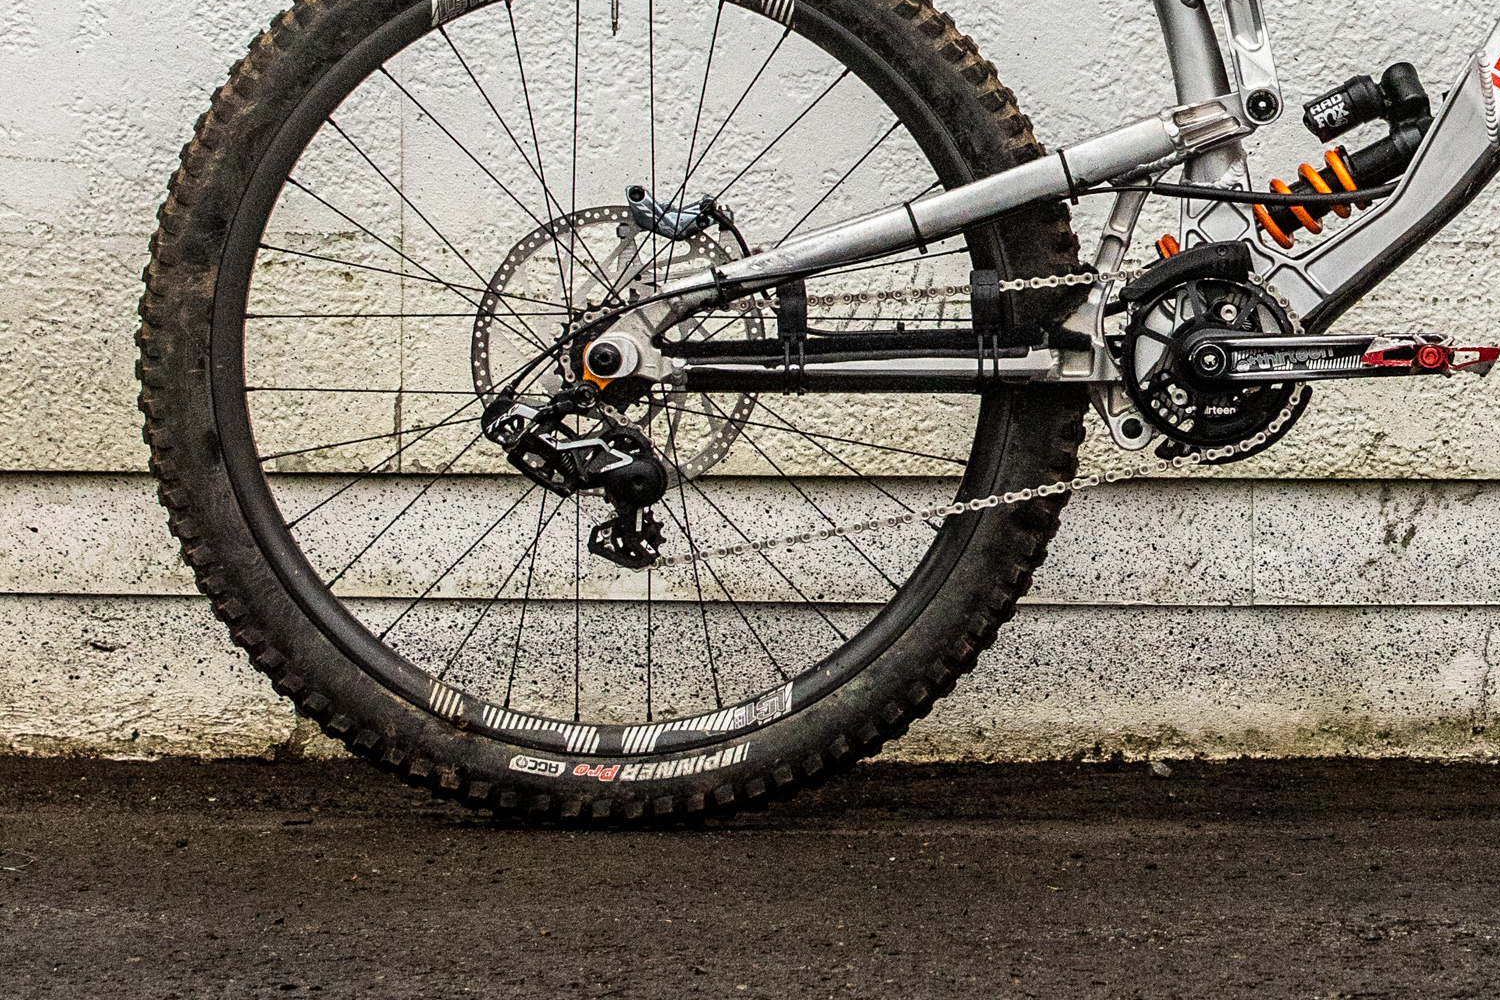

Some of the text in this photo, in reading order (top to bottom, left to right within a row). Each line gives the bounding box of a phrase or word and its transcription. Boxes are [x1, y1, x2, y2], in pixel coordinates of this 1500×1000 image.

[1309, 94, 1342, 115] RAD
[1314, 102, 1349, 128] FOX
[573, 764, 621, 782] Pro
[620, 751, 722, 781] PINNER
